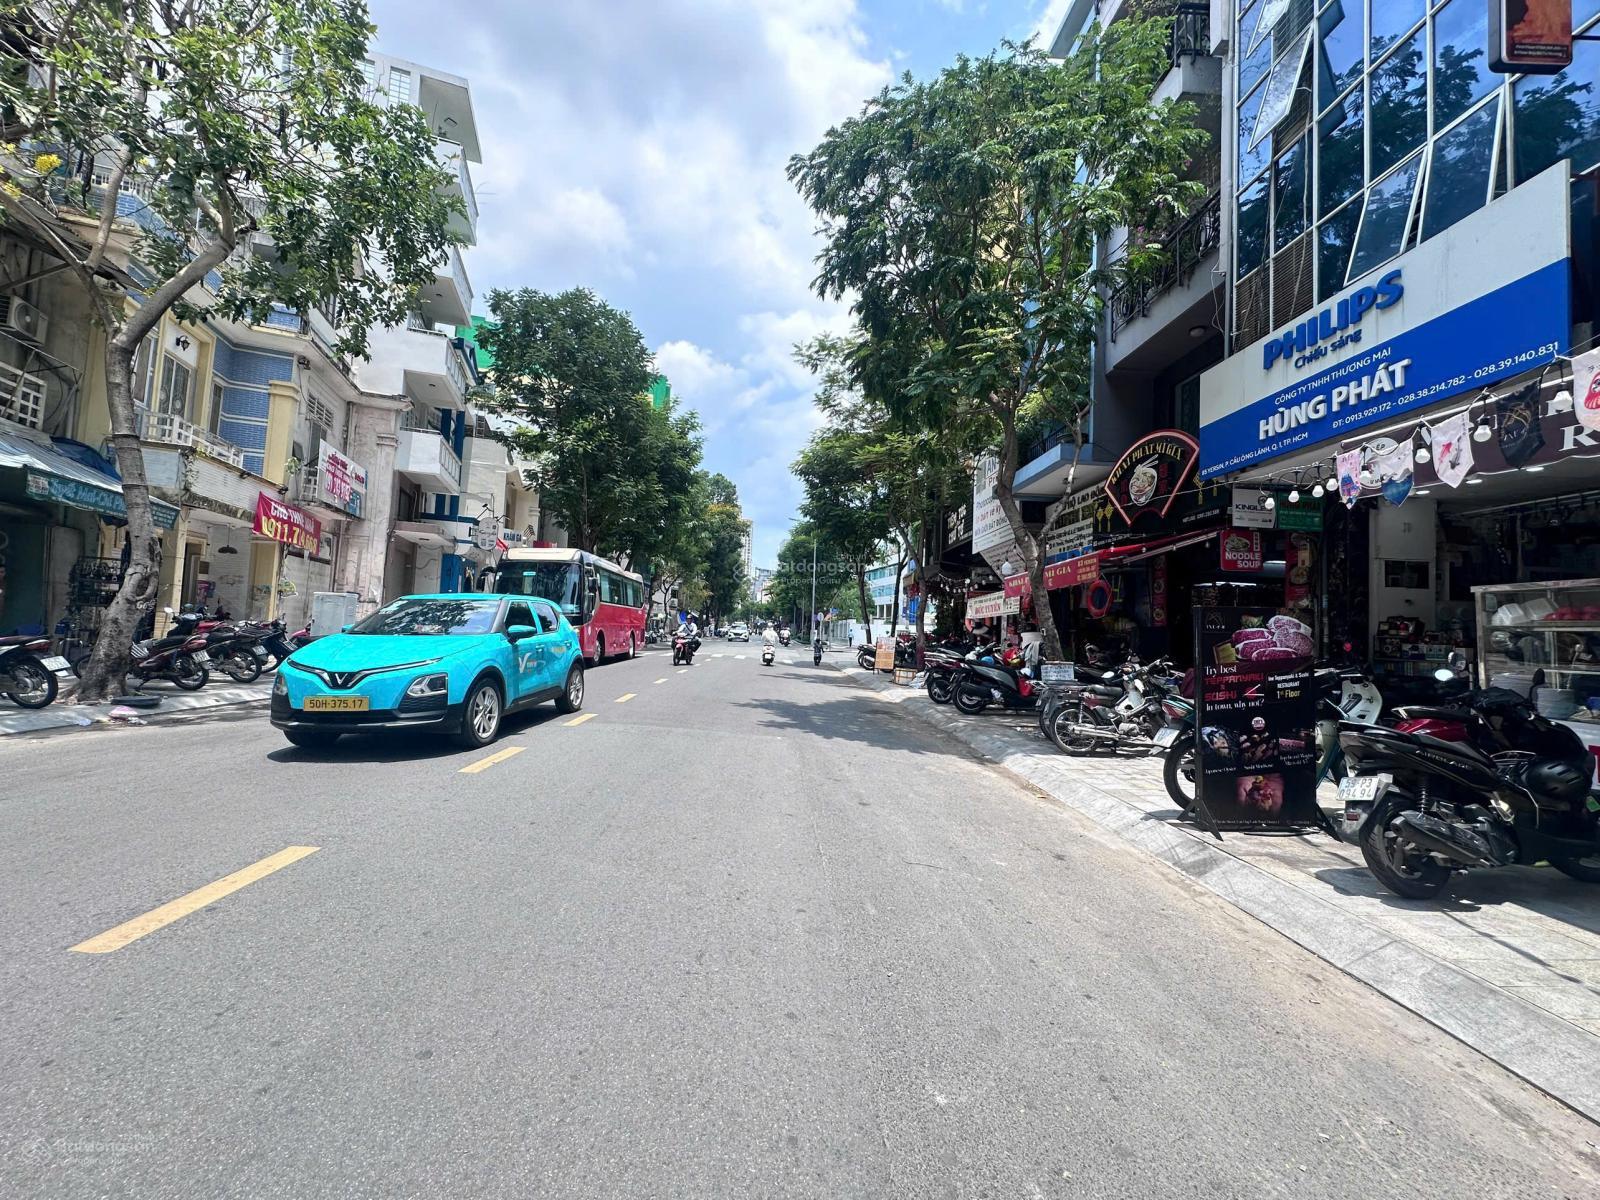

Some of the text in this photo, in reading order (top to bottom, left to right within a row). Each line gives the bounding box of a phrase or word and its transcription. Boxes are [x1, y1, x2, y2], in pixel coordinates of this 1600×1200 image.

[1263, 269, 1404, 370] PHILIPS
[1295, 329, 1362, 368] Chiếu sáng
[1275, 347, 1391, 405] CÔNG TY TNHH THƯƠNG MẠI
[1332, 419, 1345, 429] ĐT:
[1345, 402, 1391, 424] 0913.929.172
[1398, 375, 1466, 405] 028.38.214.782
[1474, 341, 1559, 379] 028.39.140.831
[1259, 358, 1412, 440] HÙNG PHÁT
[1292, 432, 1309, 442] HCM
[1226, 552, 1260, 560] NOODLE
[1237, 560, 1260, 568] SOUP
[1220, 664, 1237, 673] best
[1285, 690, 1300, 698] Floor
[309, 699, 364, 710] 50H-375.17
